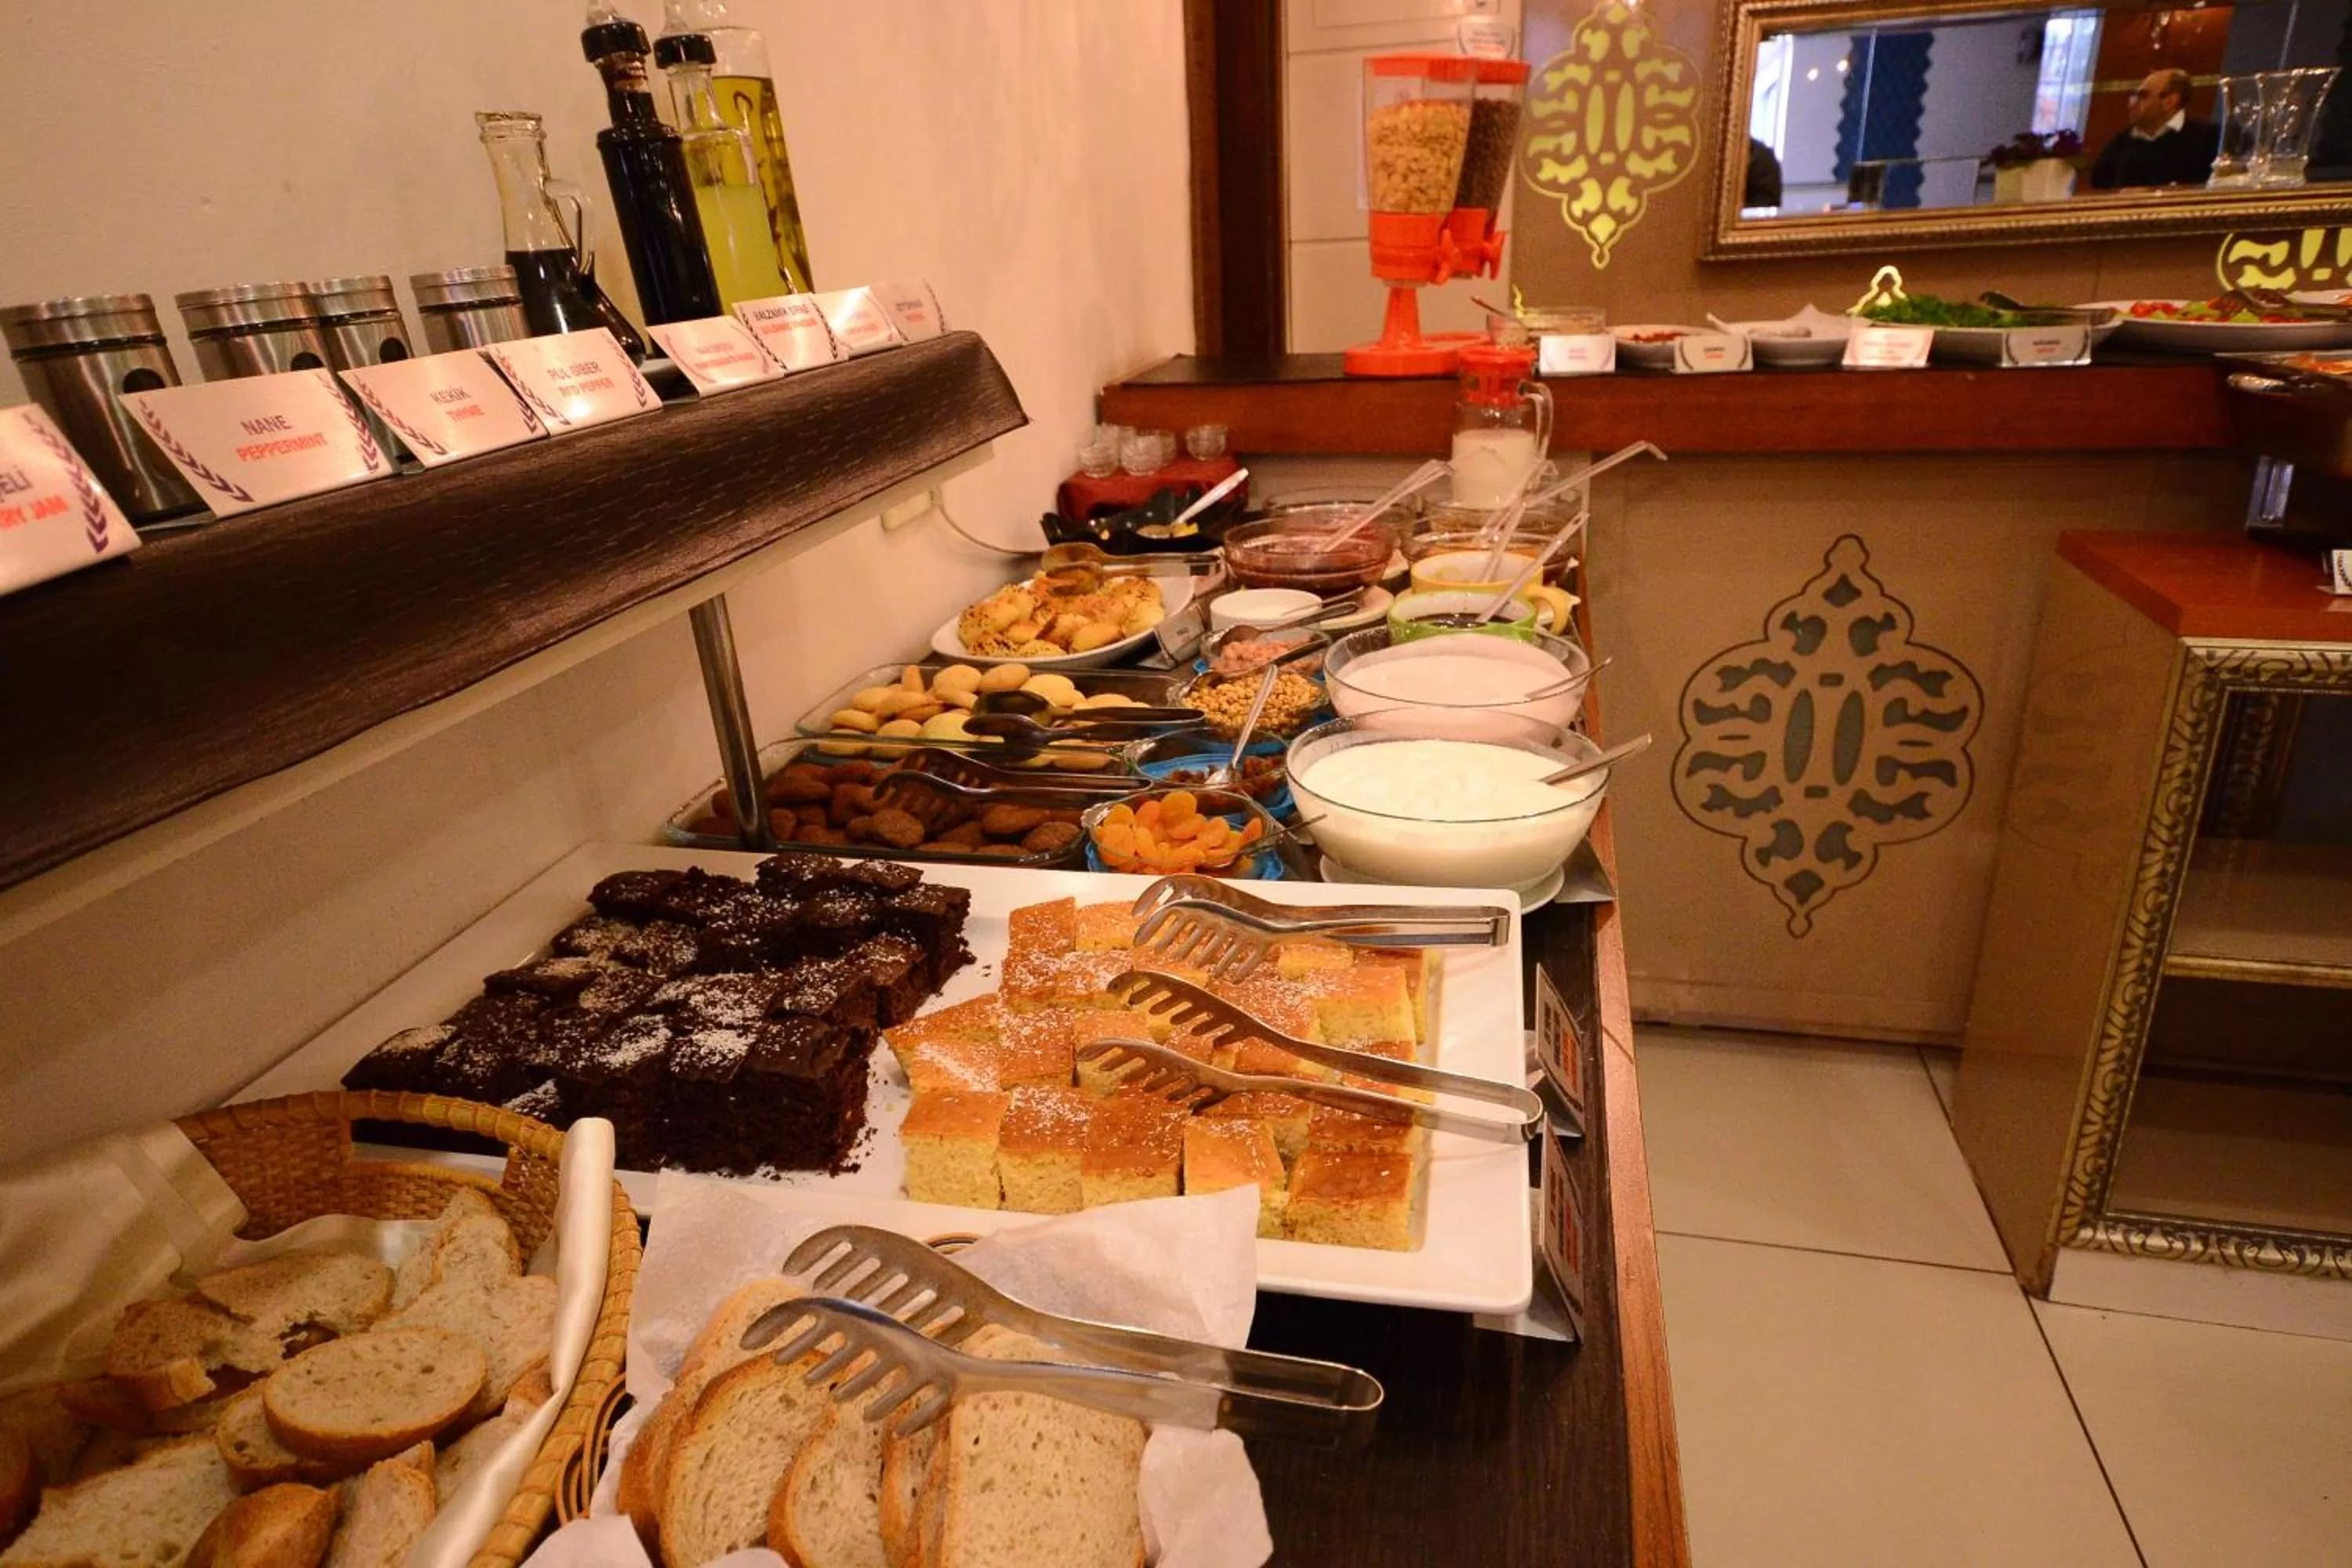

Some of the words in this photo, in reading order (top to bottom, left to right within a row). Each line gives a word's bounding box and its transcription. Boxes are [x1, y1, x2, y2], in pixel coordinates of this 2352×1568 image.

[240, 415, 292, 436] NANE
[236, 432, 328, 463] PEPPERMINT
[28, 495, 71, 521] JAM
